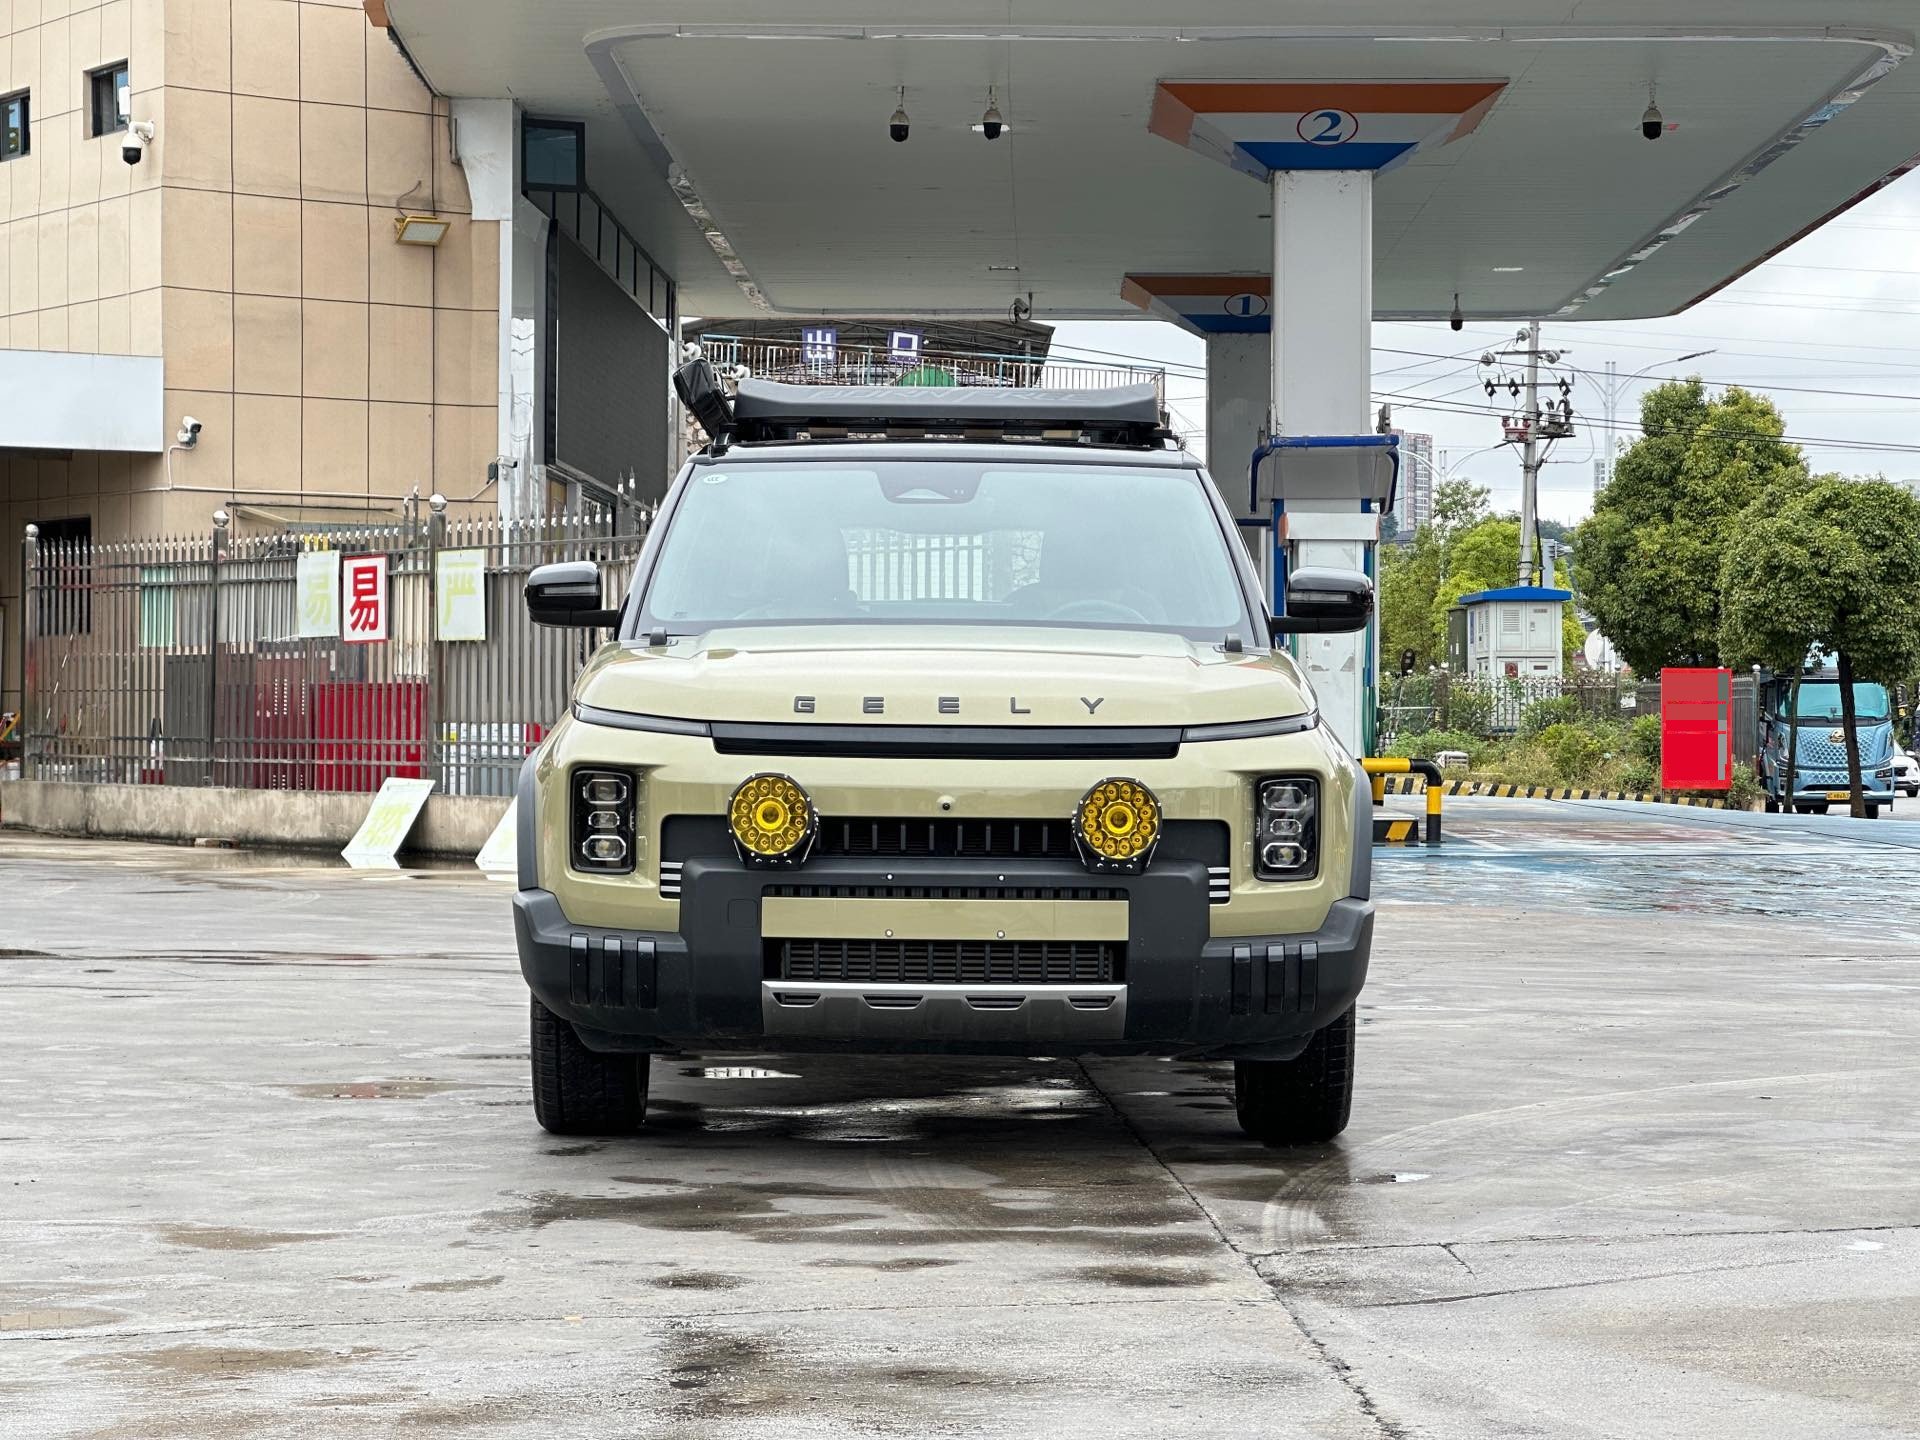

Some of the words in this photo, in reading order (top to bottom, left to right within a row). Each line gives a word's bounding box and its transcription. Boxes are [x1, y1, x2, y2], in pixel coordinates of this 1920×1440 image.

[1312, 110, 1343, 142] 2
[1237, 295, 1252, 315] 1
[349, 564, 380, 633] 易
[793, 696, 1105, 714] GEELY
